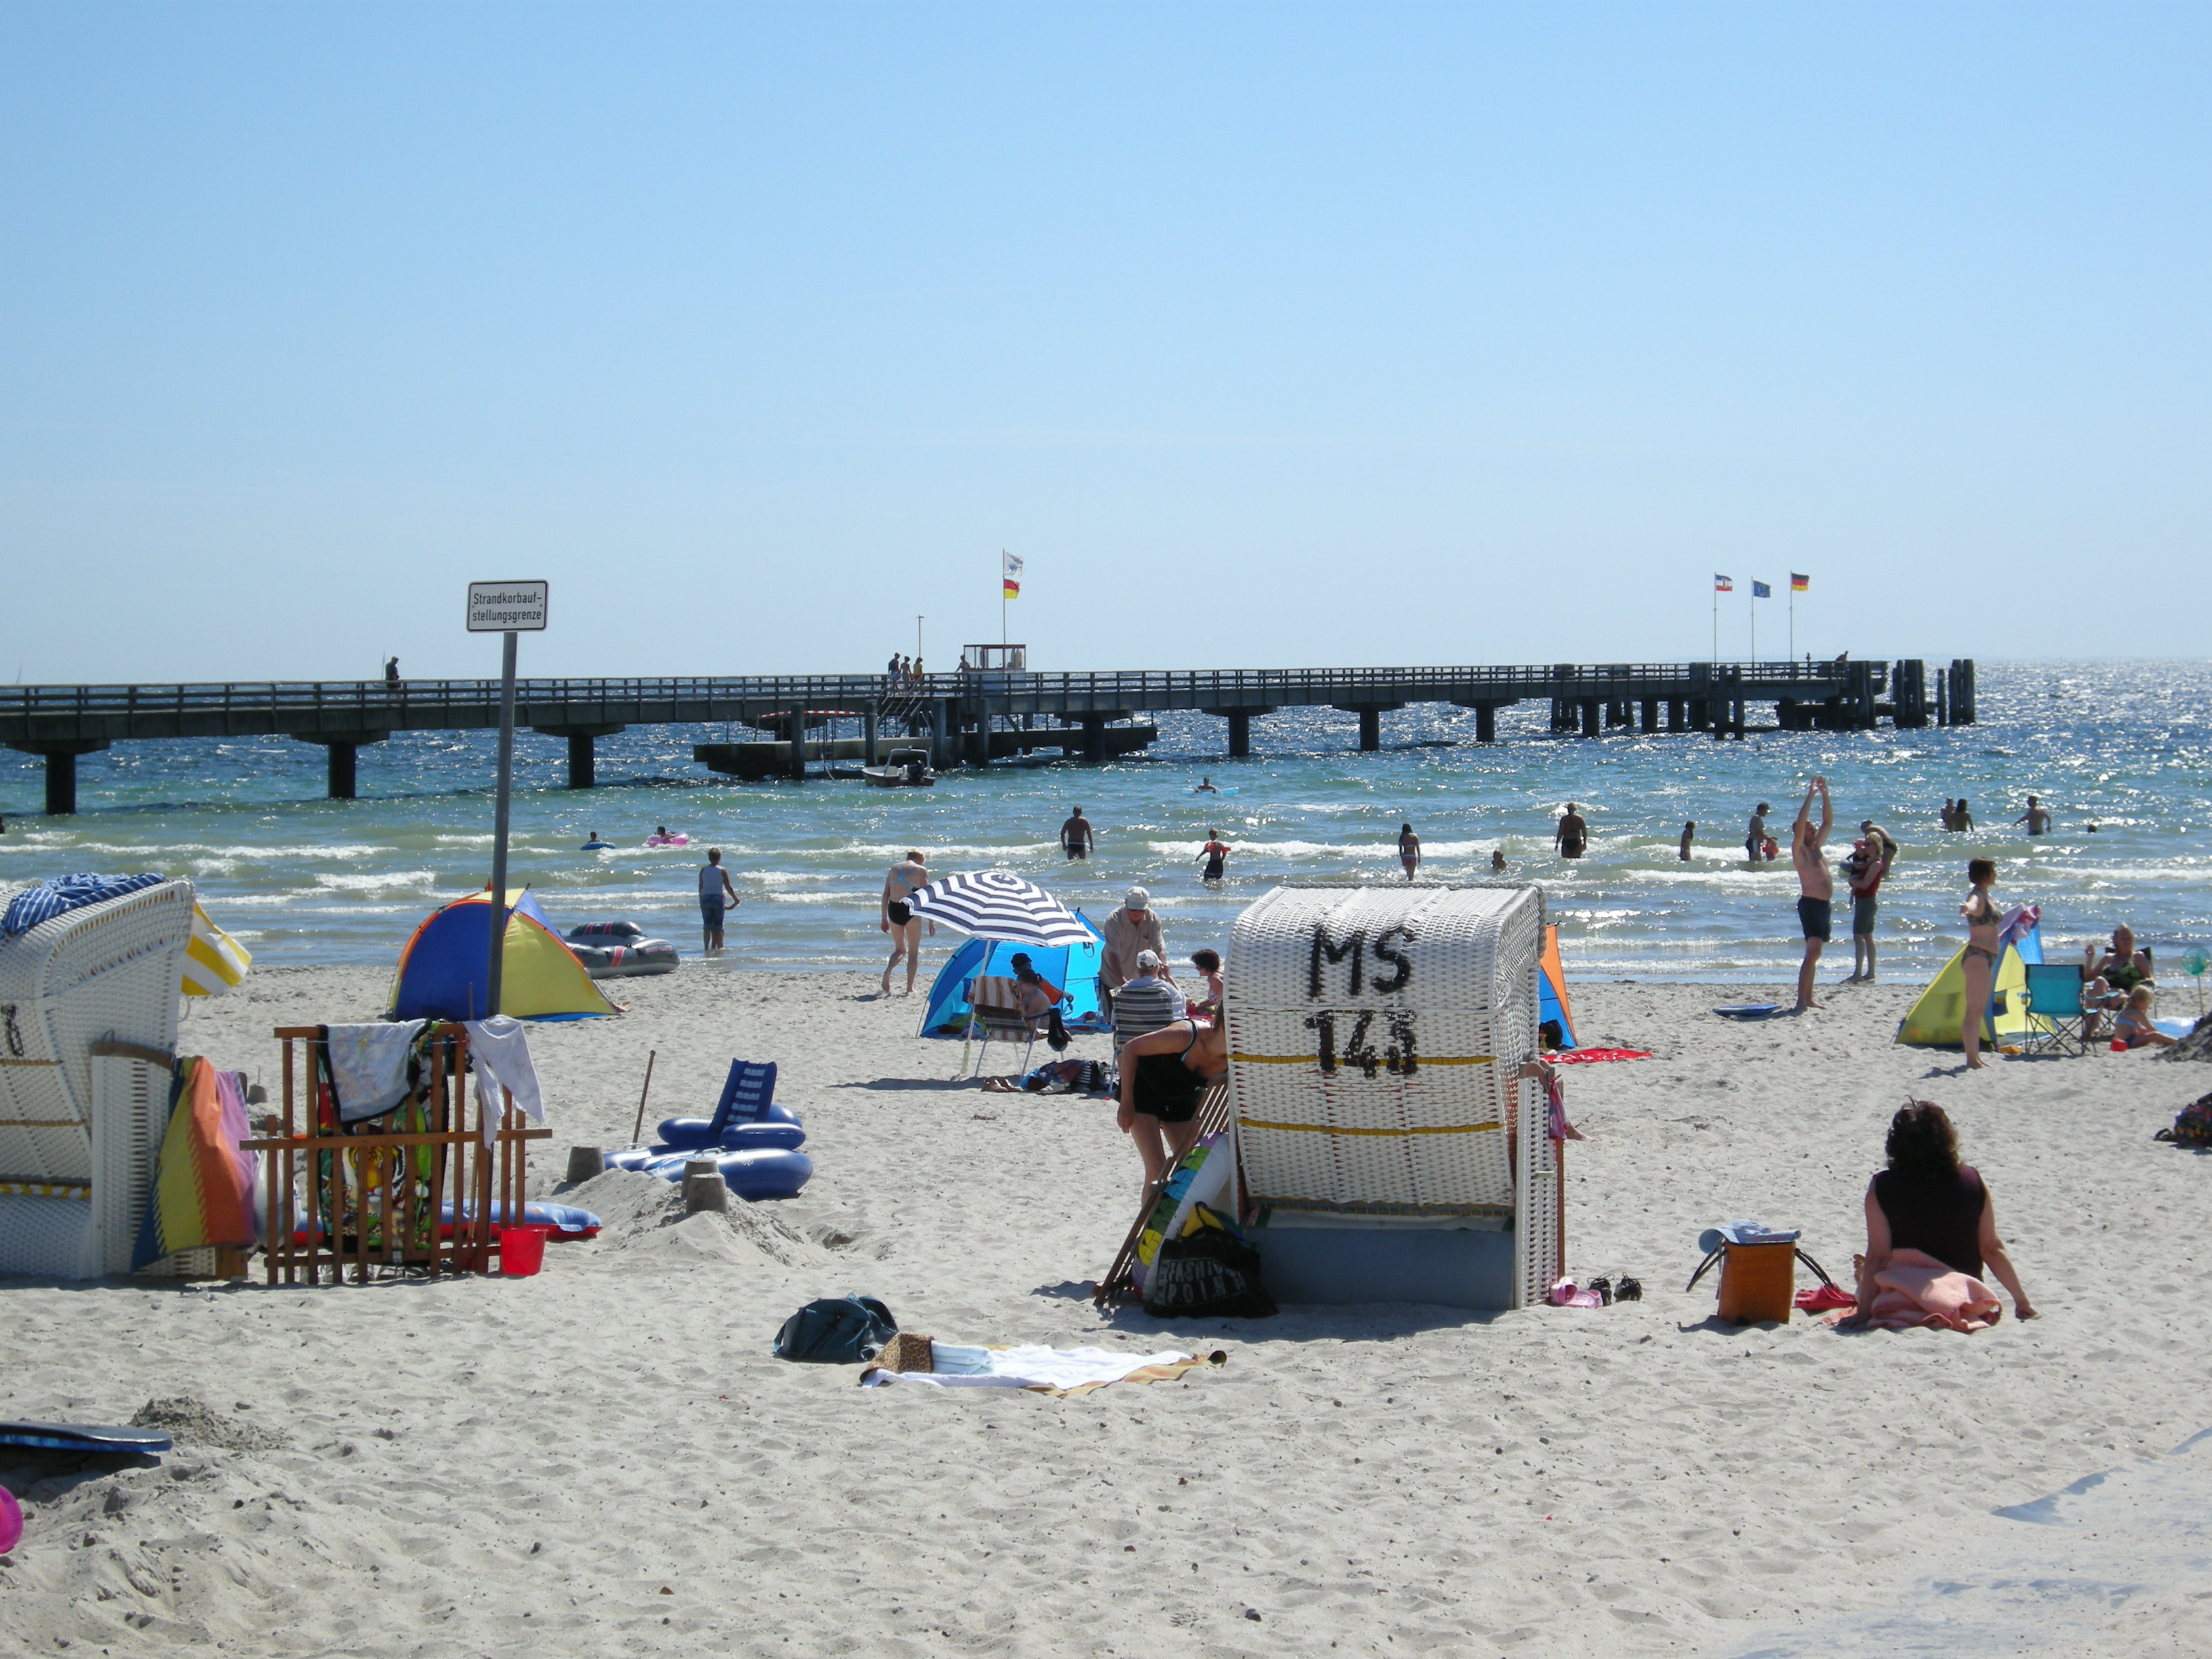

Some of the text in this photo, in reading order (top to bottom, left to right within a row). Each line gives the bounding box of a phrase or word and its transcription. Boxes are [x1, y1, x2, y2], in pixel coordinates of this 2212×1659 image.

[473, 592, 541, 605] Strandkorbauf-
[472, 609, 541, 623] stellungsgrenze
[1309, 926, 1415, 997] MS
